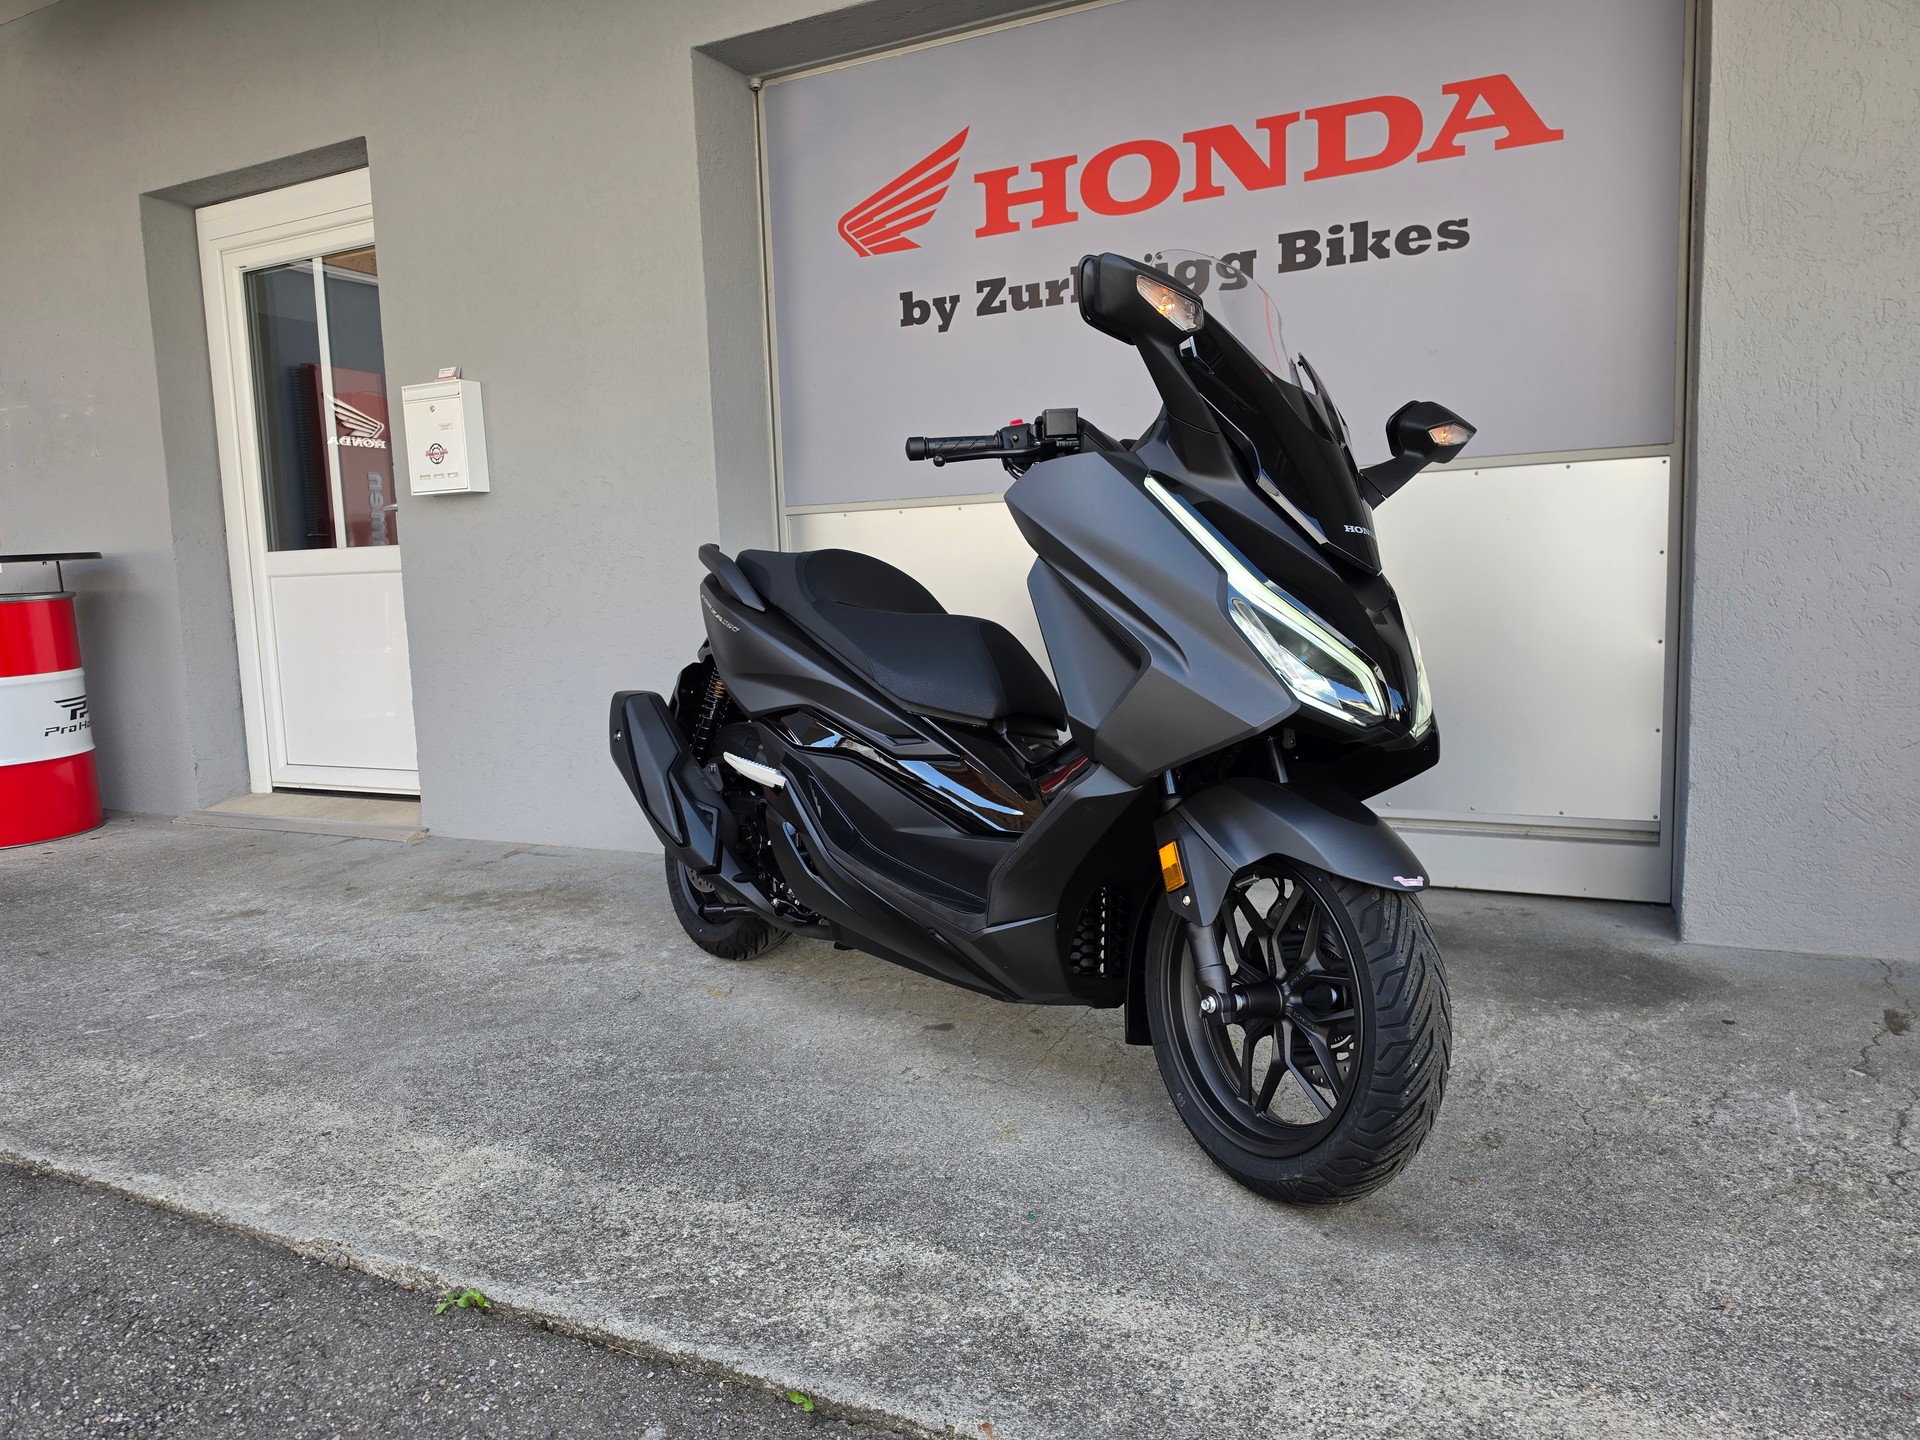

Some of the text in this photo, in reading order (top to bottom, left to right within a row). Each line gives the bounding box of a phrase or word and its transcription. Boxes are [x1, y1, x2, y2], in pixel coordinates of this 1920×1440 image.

[974, 74, 1564, 238] HONDA
[900, 218, 1470, 333] by Zurgg Bikes
